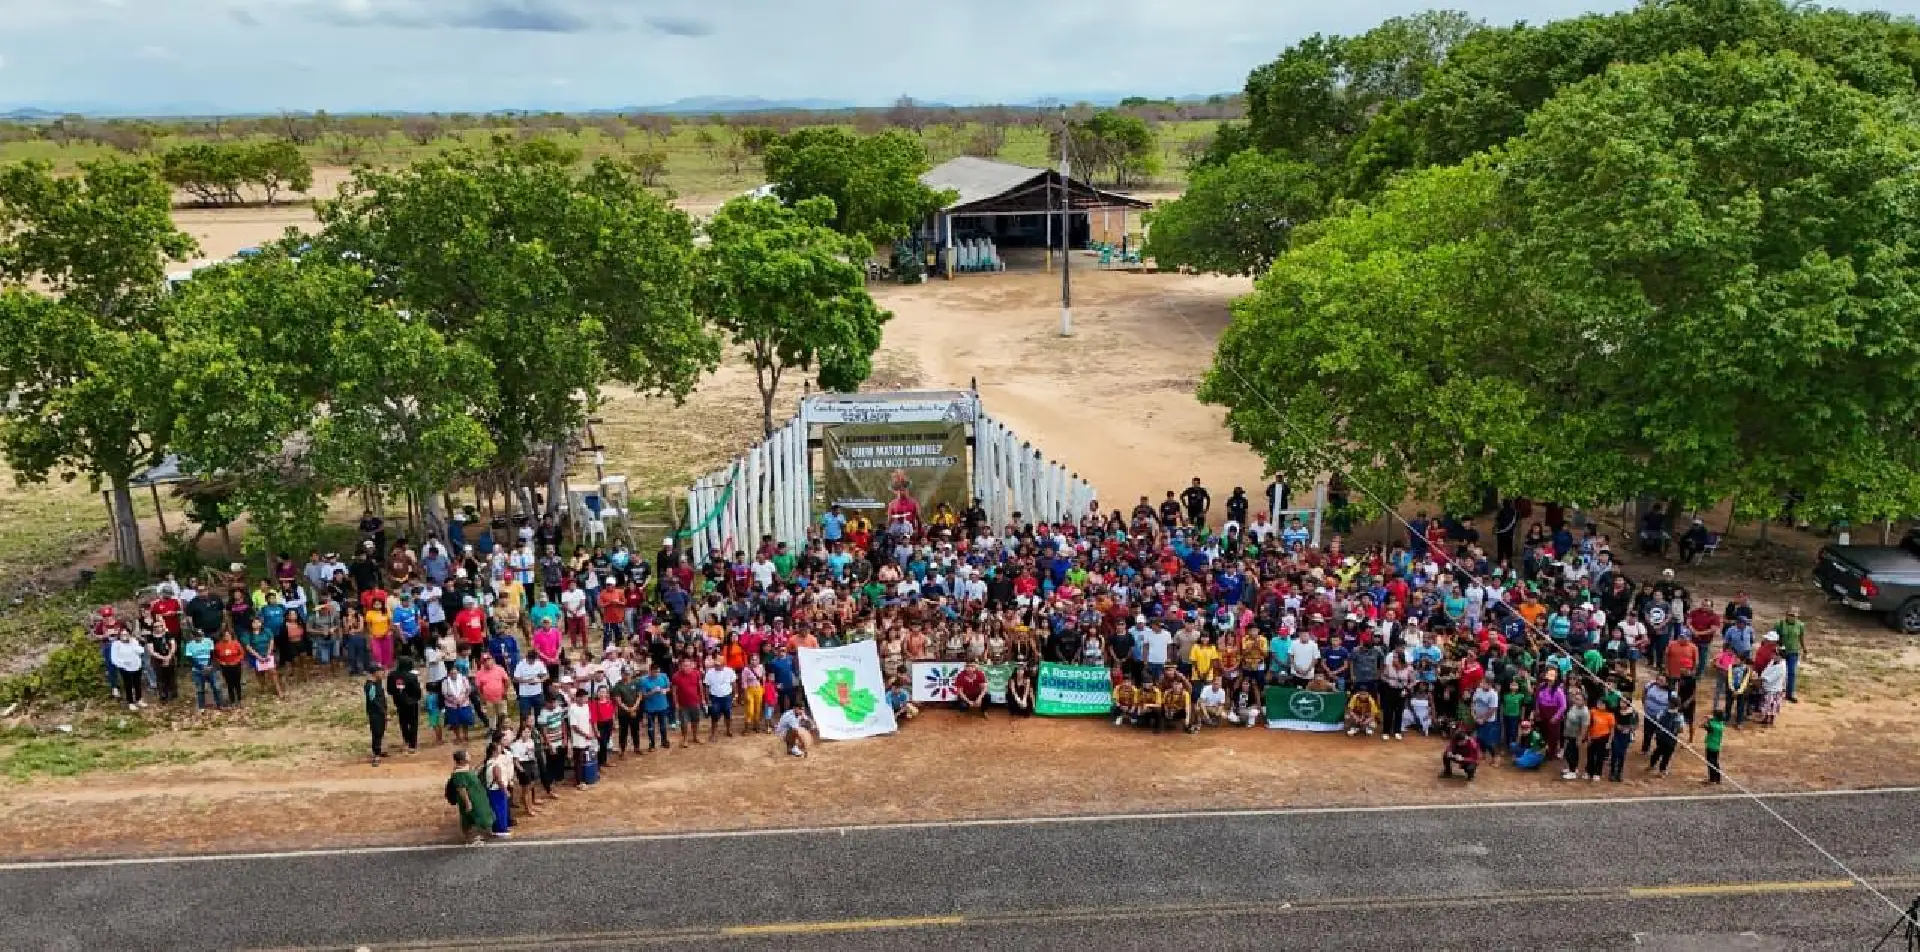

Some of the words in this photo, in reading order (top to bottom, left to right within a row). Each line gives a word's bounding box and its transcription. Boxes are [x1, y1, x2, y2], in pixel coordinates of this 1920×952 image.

[1041, 667, 1048, 675] A
[1054, 667, 1111, 680] RESPOSTA
[1041, 677, 1083, 689] SOMOS
